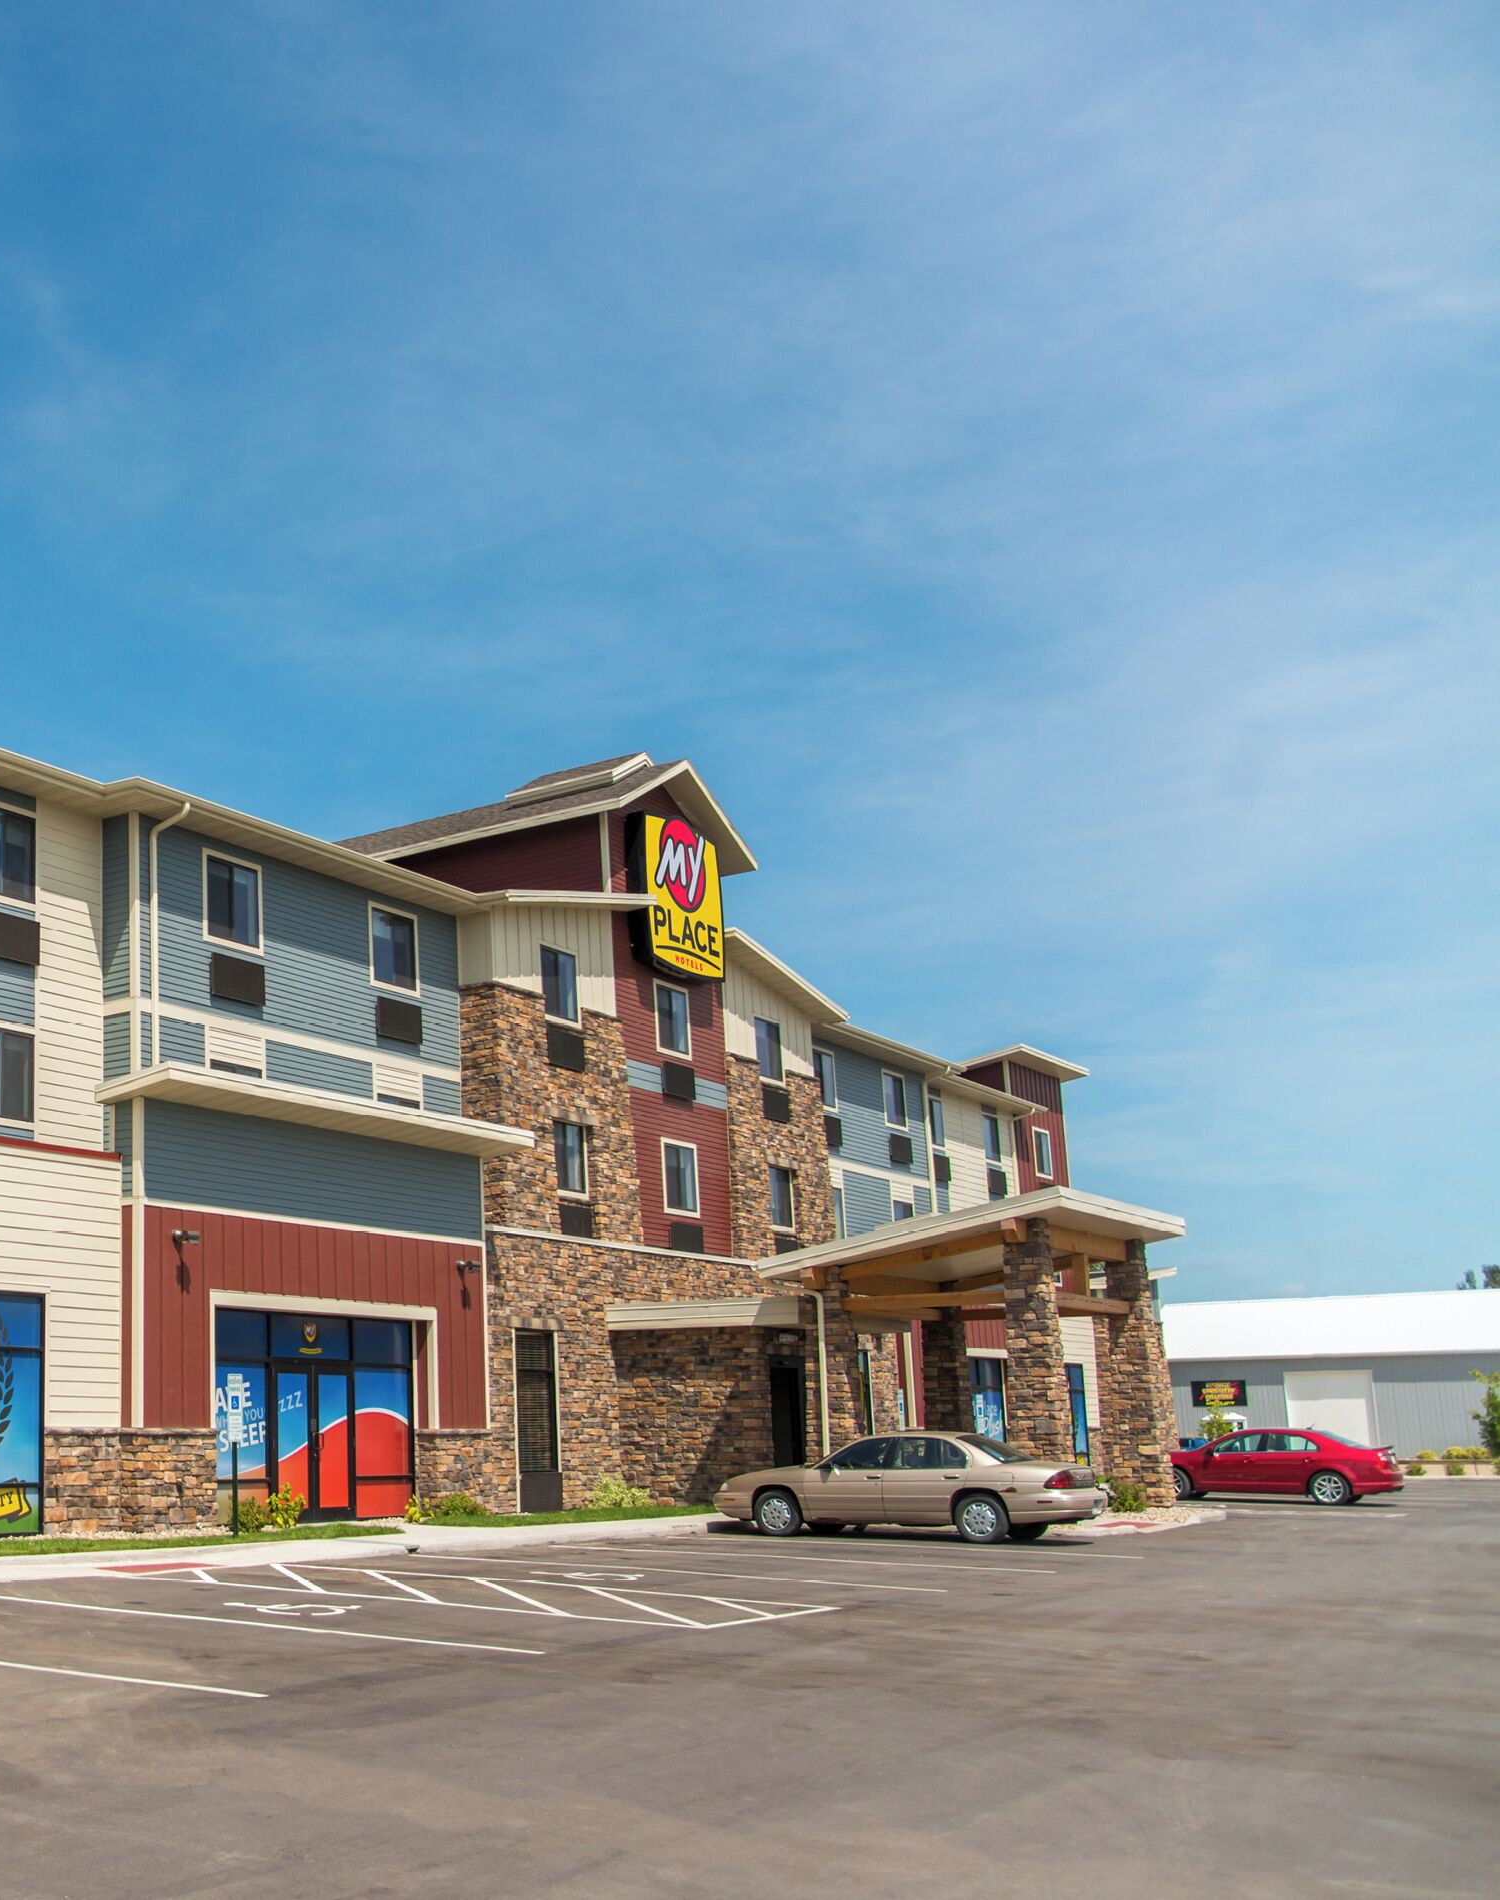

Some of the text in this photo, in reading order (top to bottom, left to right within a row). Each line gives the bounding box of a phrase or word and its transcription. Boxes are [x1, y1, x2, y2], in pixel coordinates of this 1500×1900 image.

[654, 905, 720, 959] PLACE
[675, 955, 704, 972] HOTELS
[219, 1421, 266, 1452] SEEP
